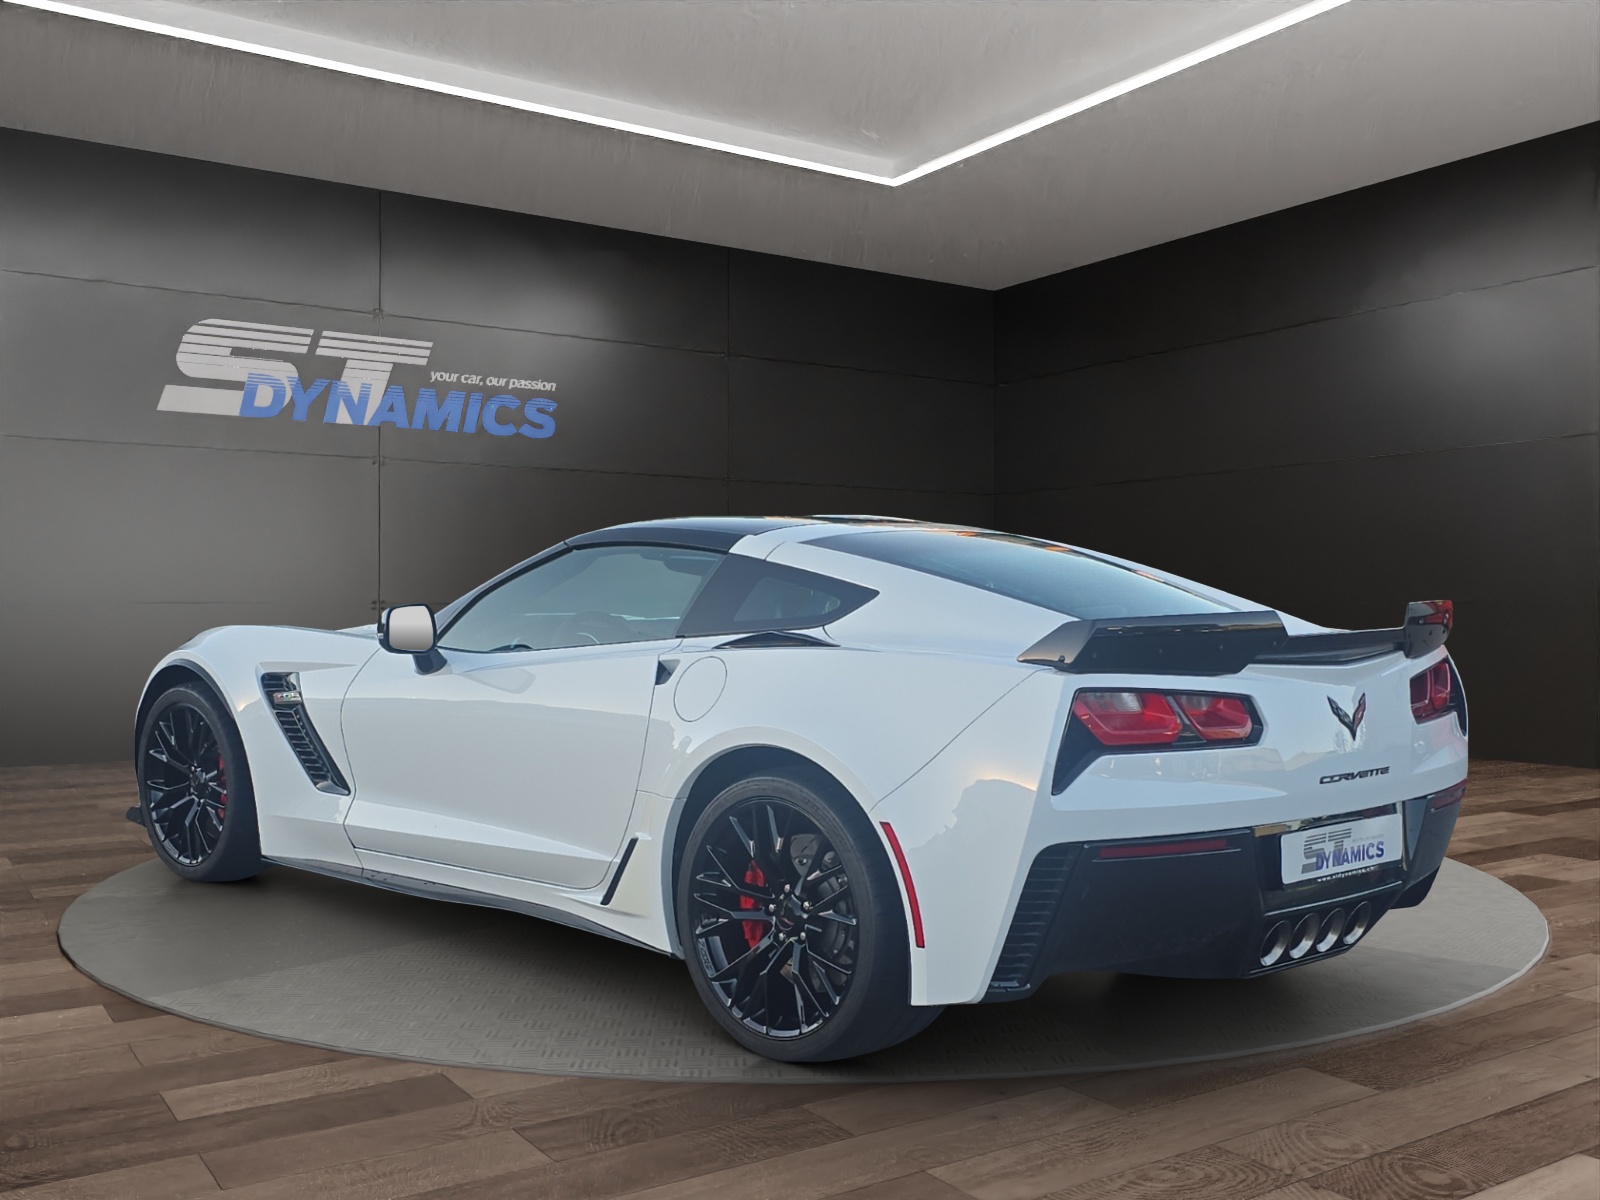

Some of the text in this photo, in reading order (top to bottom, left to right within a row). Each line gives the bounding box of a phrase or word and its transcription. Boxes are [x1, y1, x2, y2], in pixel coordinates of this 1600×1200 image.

[430, 371, 557, 392] your car, our passion
[239, 372, 558, 439] DYNAMICS
[1319, 766, 1390, 784] CORVETTE
[1315, 841, 1385, 871] DYNAMICS
